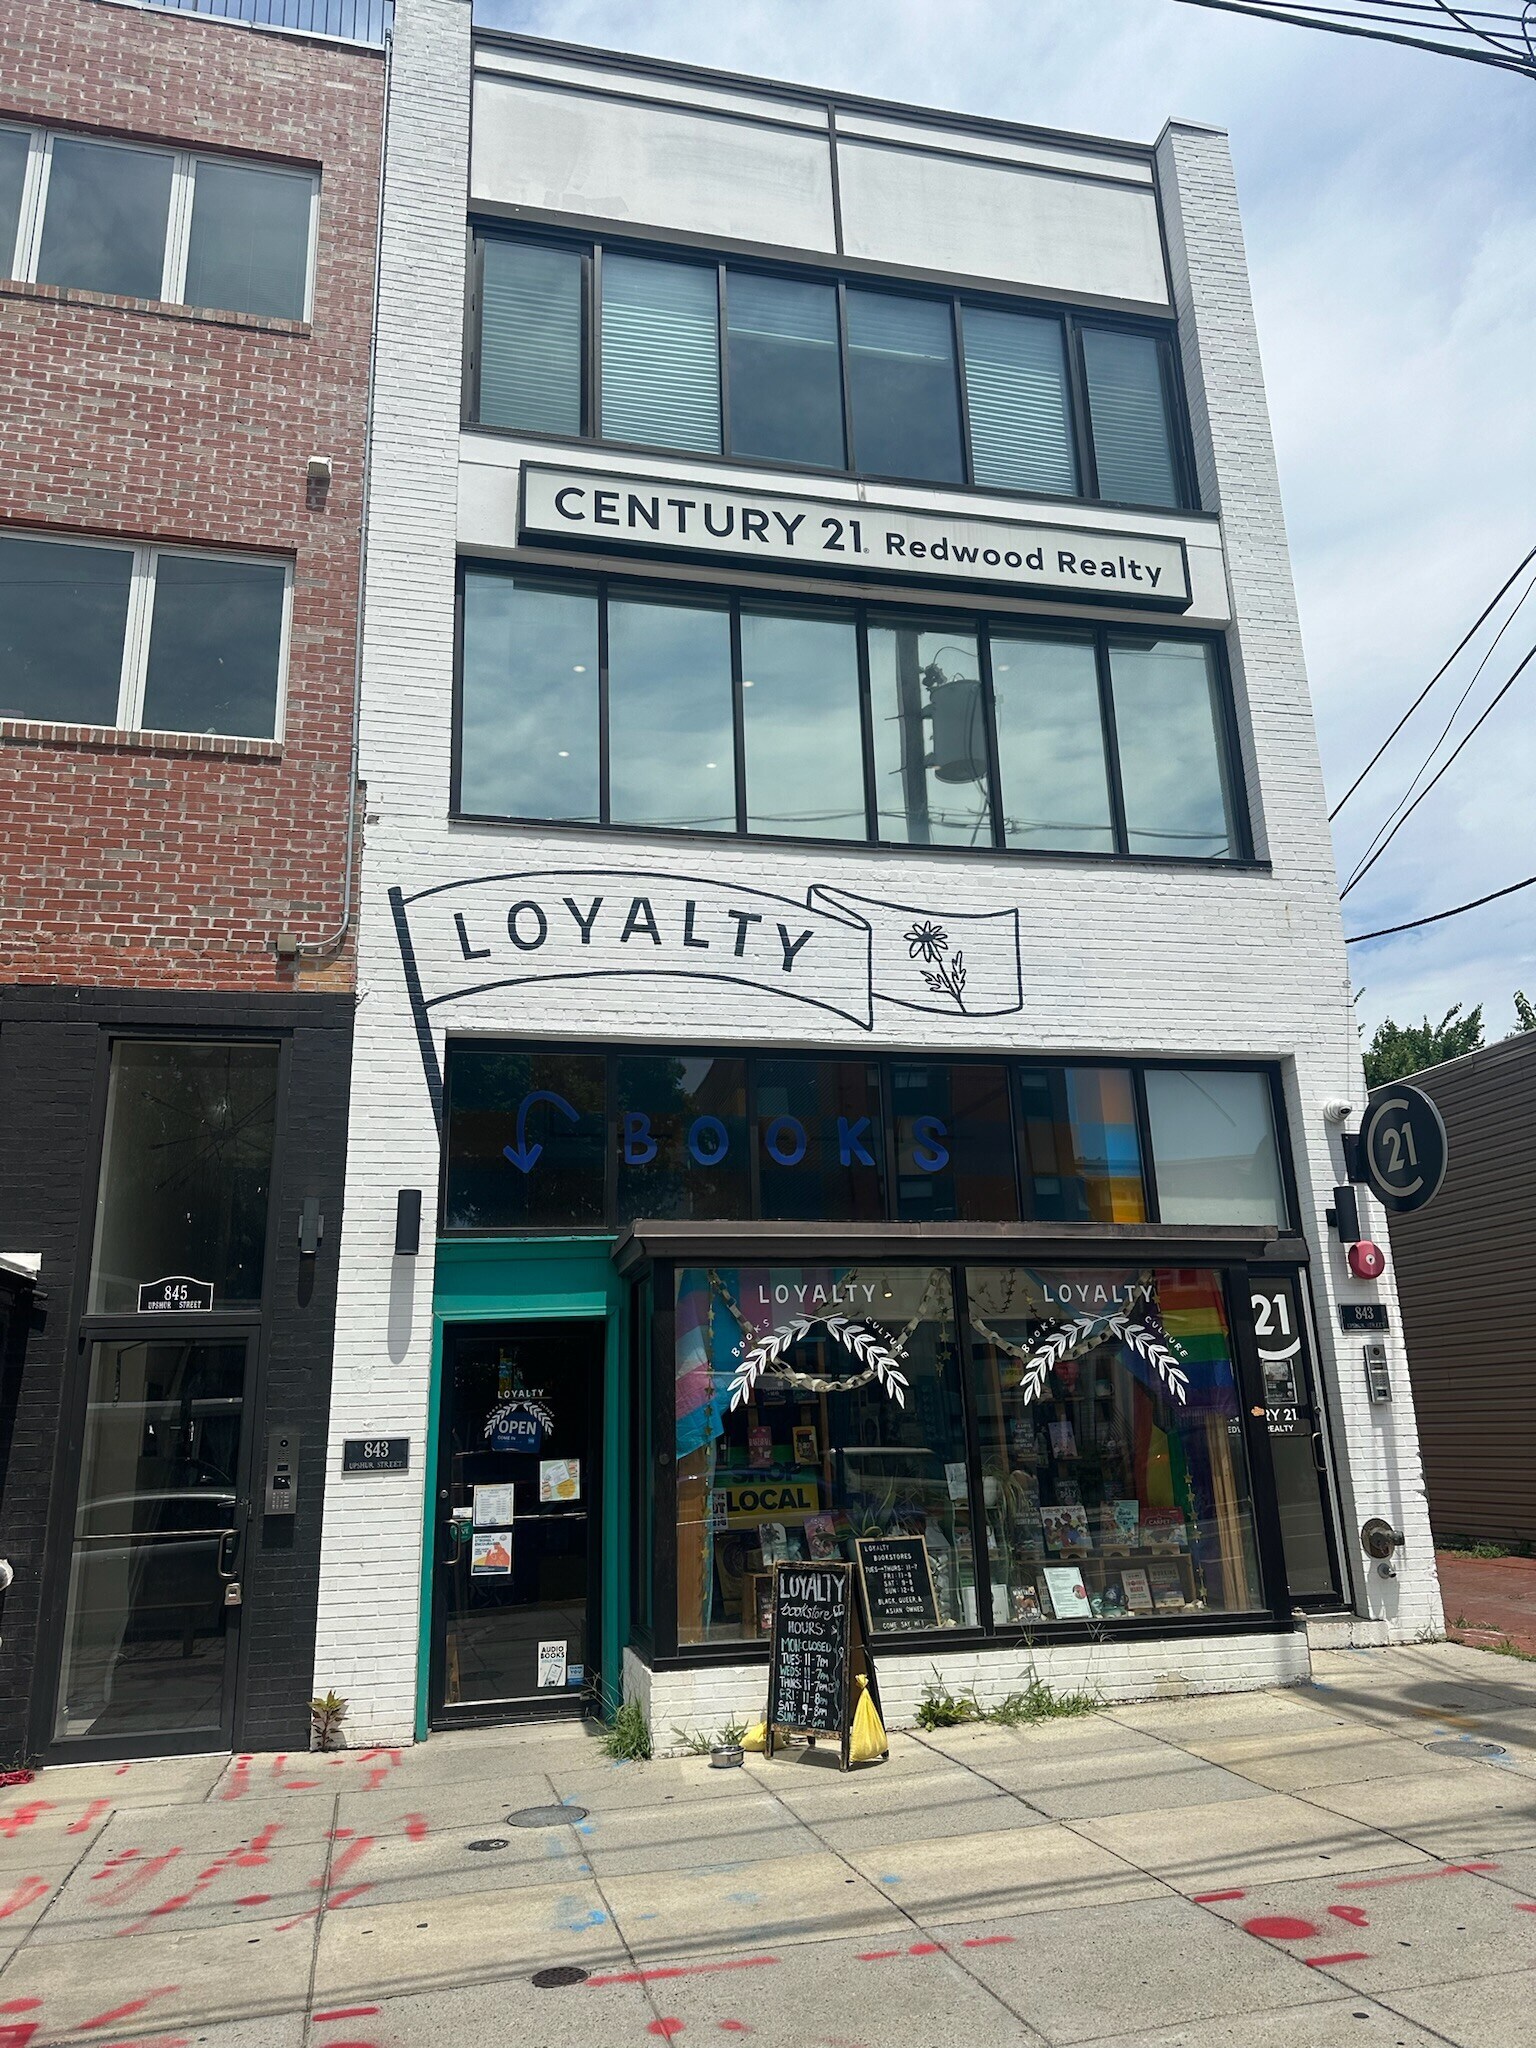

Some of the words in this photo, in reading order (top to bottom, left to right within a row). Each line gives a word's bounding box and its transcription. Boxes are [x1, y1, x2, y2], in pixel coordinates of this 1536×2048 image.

[554, 487, 806, 546] CENTURY
[885, 532, 1044, 571] Redwood
[1057, 550, 1162, 588] Realty
[454, 896, 815, 973] LOYALTY
[622, 1111, 950, 1173] BOOKS
[1382, 1121, 1418, 1173] 21
[164, 1284, 188, 1301] 845
[758, 1283, 876, 1304] LOYALTY
[1042, 1284, 1154, 1303] LOYALTY
[147, 1301, 172, 1309] UPSHUR
[178, 1300, 202, 1309] STREET
[1250, 1293, 1291, 1336] 21
[1354, 1306, 1374, 1320] 843
[731, 1318, 770, 1358] BOOKS
[865, 1315, 910, 1360] CULTURE
[1021, 1316, 1056, 1354] BOOKS
[1144, 1315, 1189, 1358] CULTURE
[497, 1388, 545, 1399] LOYALTY
[498, 1419, 537, 1435] OPEN
[363, 1440, 389, 1459] 843
[377, 1460, 403, 1469] STREET
[726, 1487, 811, 1512] LOCAL
[863, 1544, 890, 1552] LOYALTY
[873, 1552, 912, 1561] BOOKSTORES
[779, 1572, 846, 1603] LOYALTY
[780, 1602, 834, 1621] bookstore
[885, 1607, 904, 1615] ASIAN
[905, 1605, 925, 1613] OWNED
[788, 1620, 826, 1636] HOURS:
[900, 1620, 911, 1628] SAY
[541, 1645, 564, 1653] AUDIO
[802, 1640, 832, 1653] CLOSED
[781, 1652, 803, 1666] TUES:
[780, 1664, 802, 1678] WEDS:
[779, 1688, 800, 1701] FRI:
[778, 1700, 797, 1712] SAT:
[776, 1710, 797, 1723] SUN:
